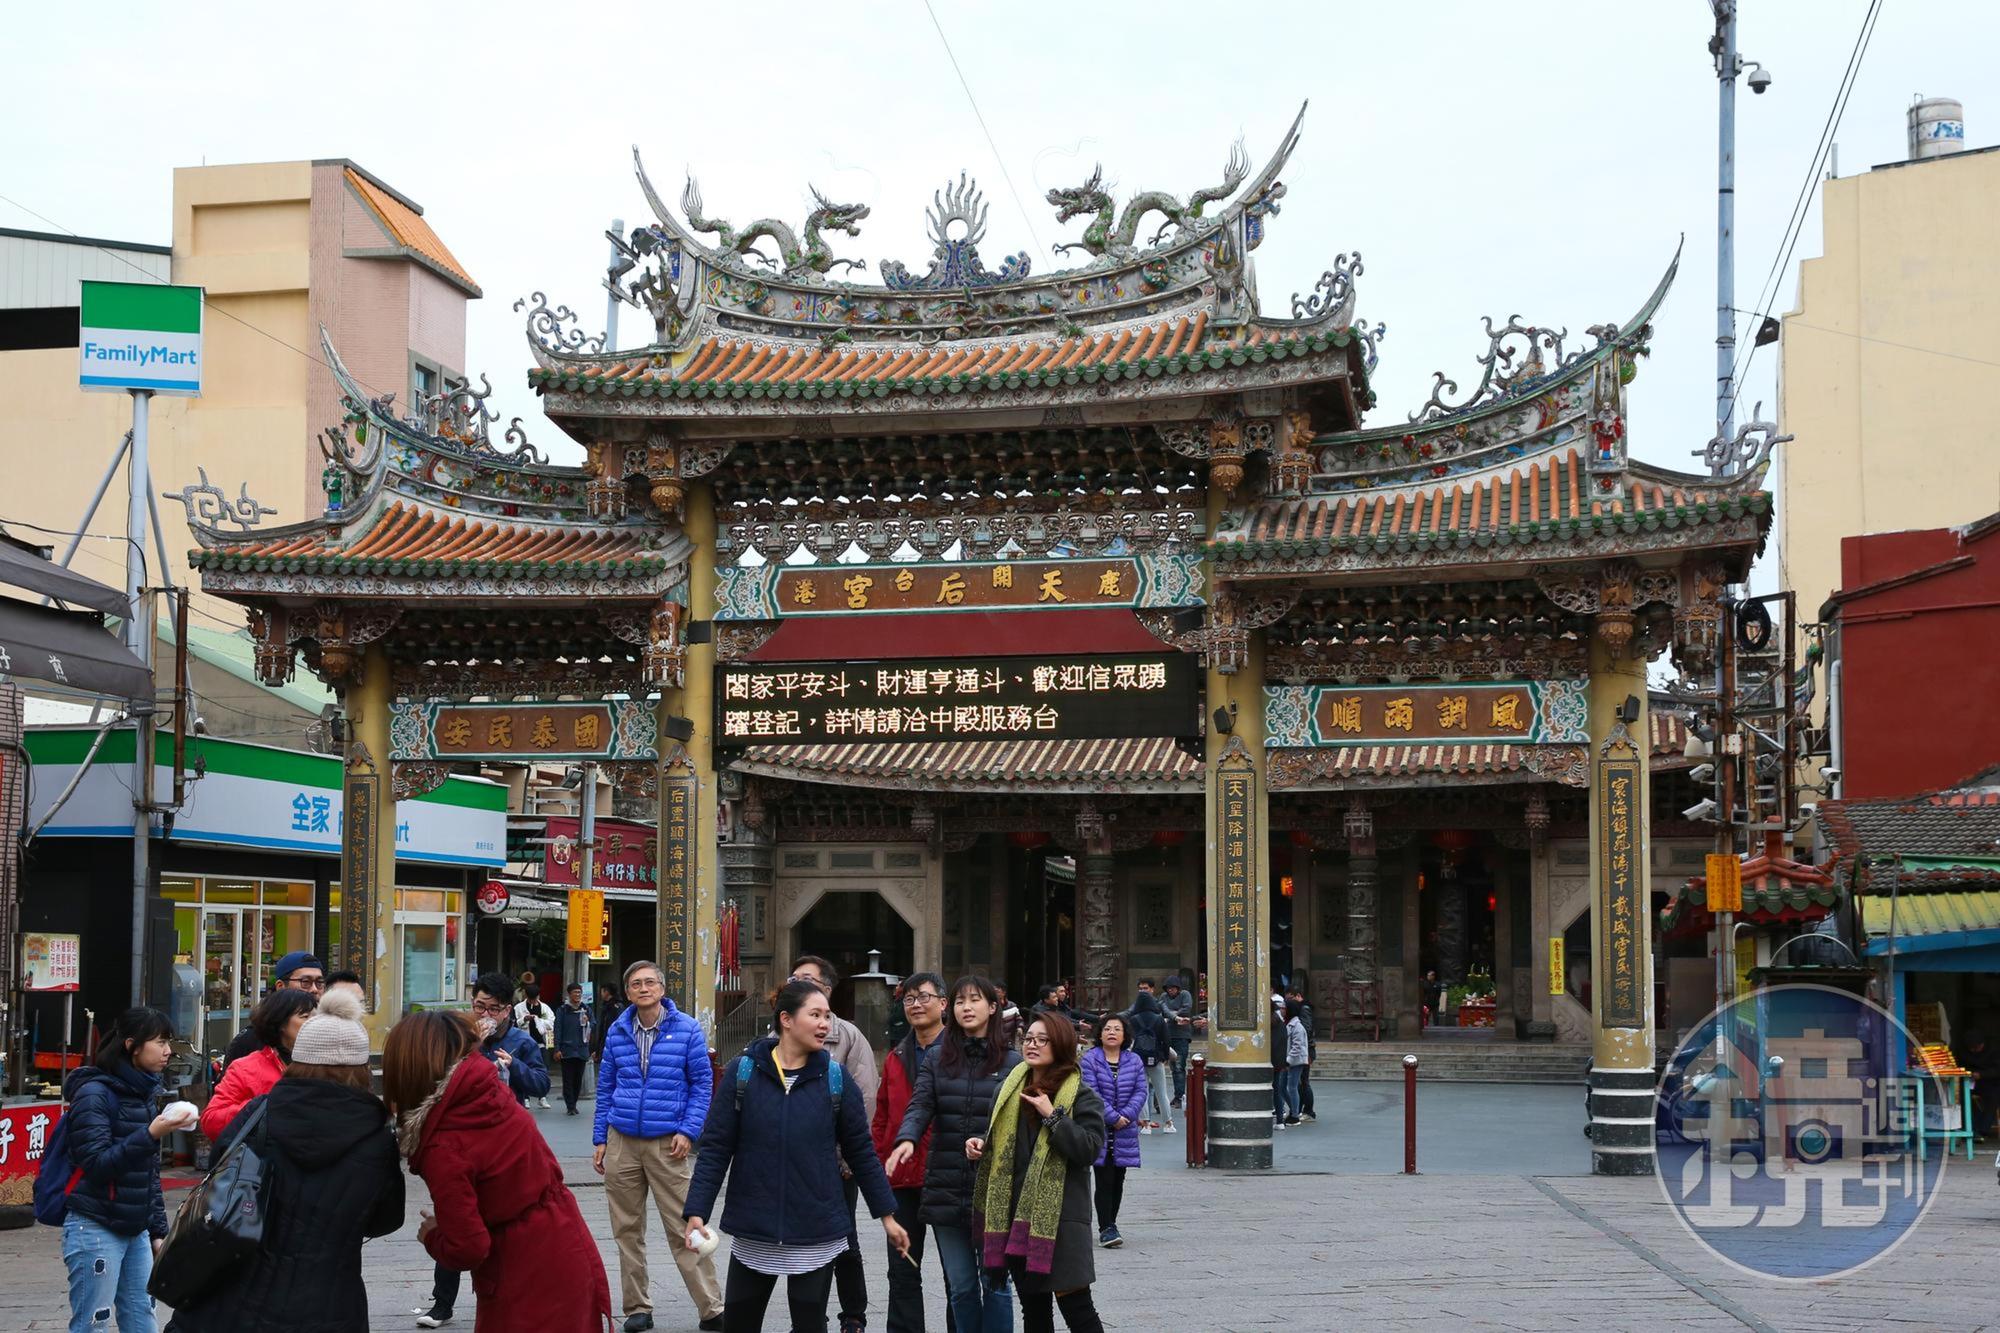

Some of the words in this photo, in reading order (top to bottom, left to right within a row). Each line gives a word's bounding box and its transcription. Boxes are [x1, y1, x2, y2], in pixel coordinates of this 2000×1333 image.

[84, 342, 197, 367] FamilyMart
[291, 792, 331, 833] 全家
[571, 832, 657, 862] 口第一家
